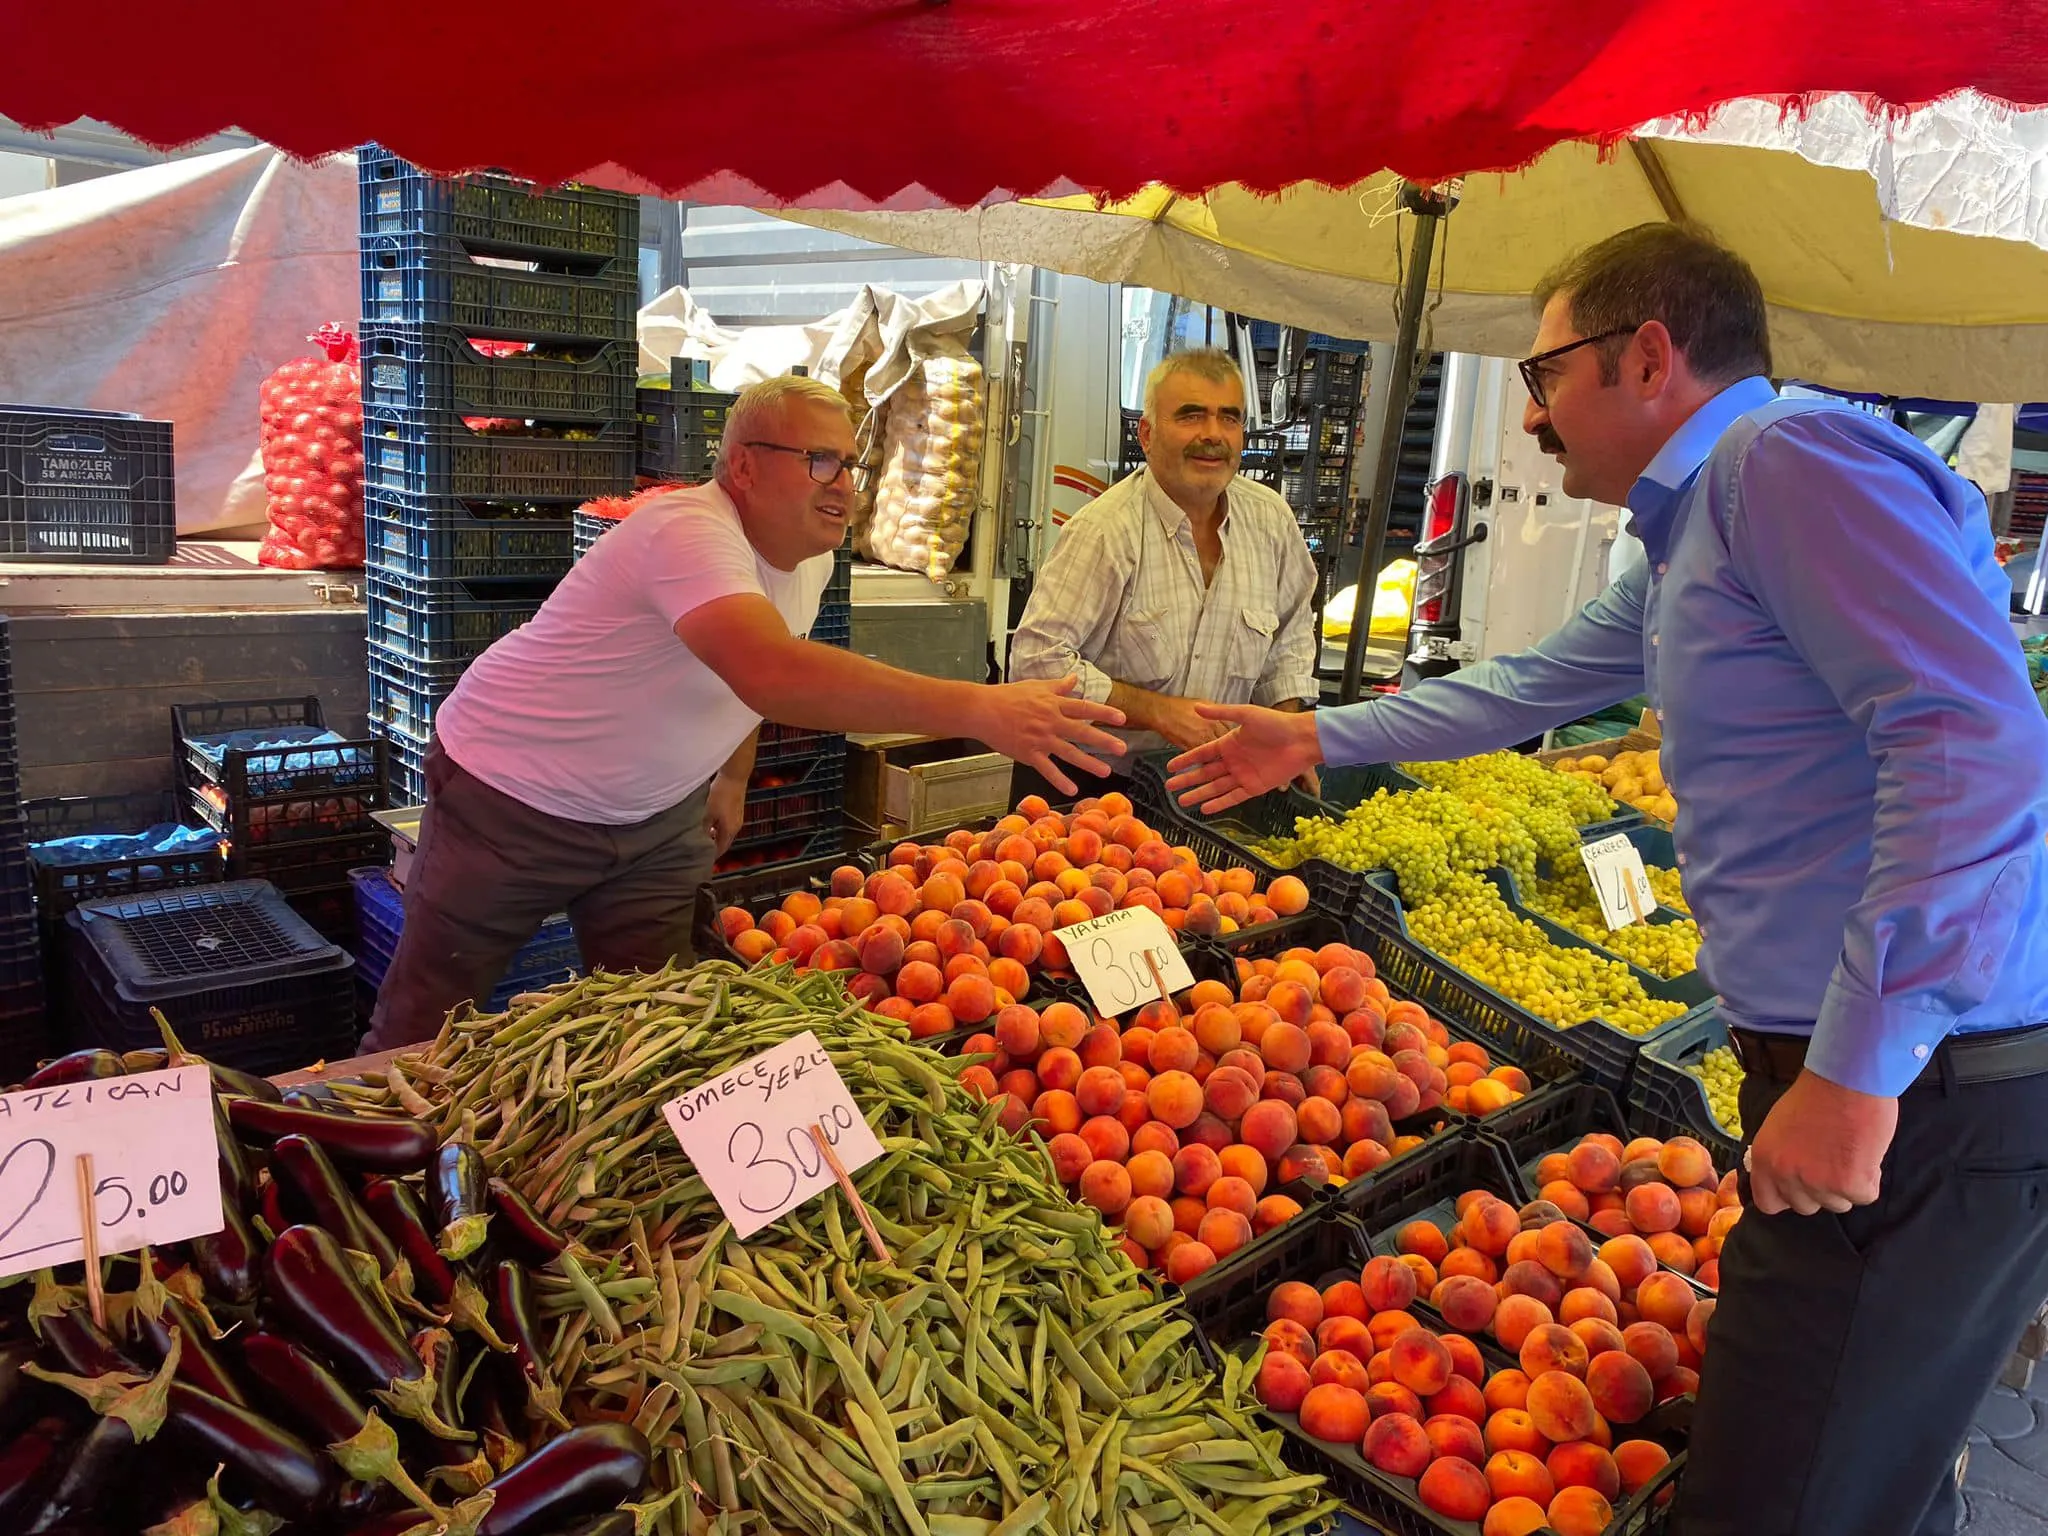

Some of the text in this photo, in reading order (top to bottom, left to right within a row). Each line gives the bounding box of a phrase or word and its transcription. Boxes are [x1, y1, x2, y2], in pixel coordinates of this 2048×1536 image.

[60, 470, 113, 481] ANKARA
[1063, 910, 1133, 940] YARMA
[675, 1060, 769, 1122] ÖMECE
